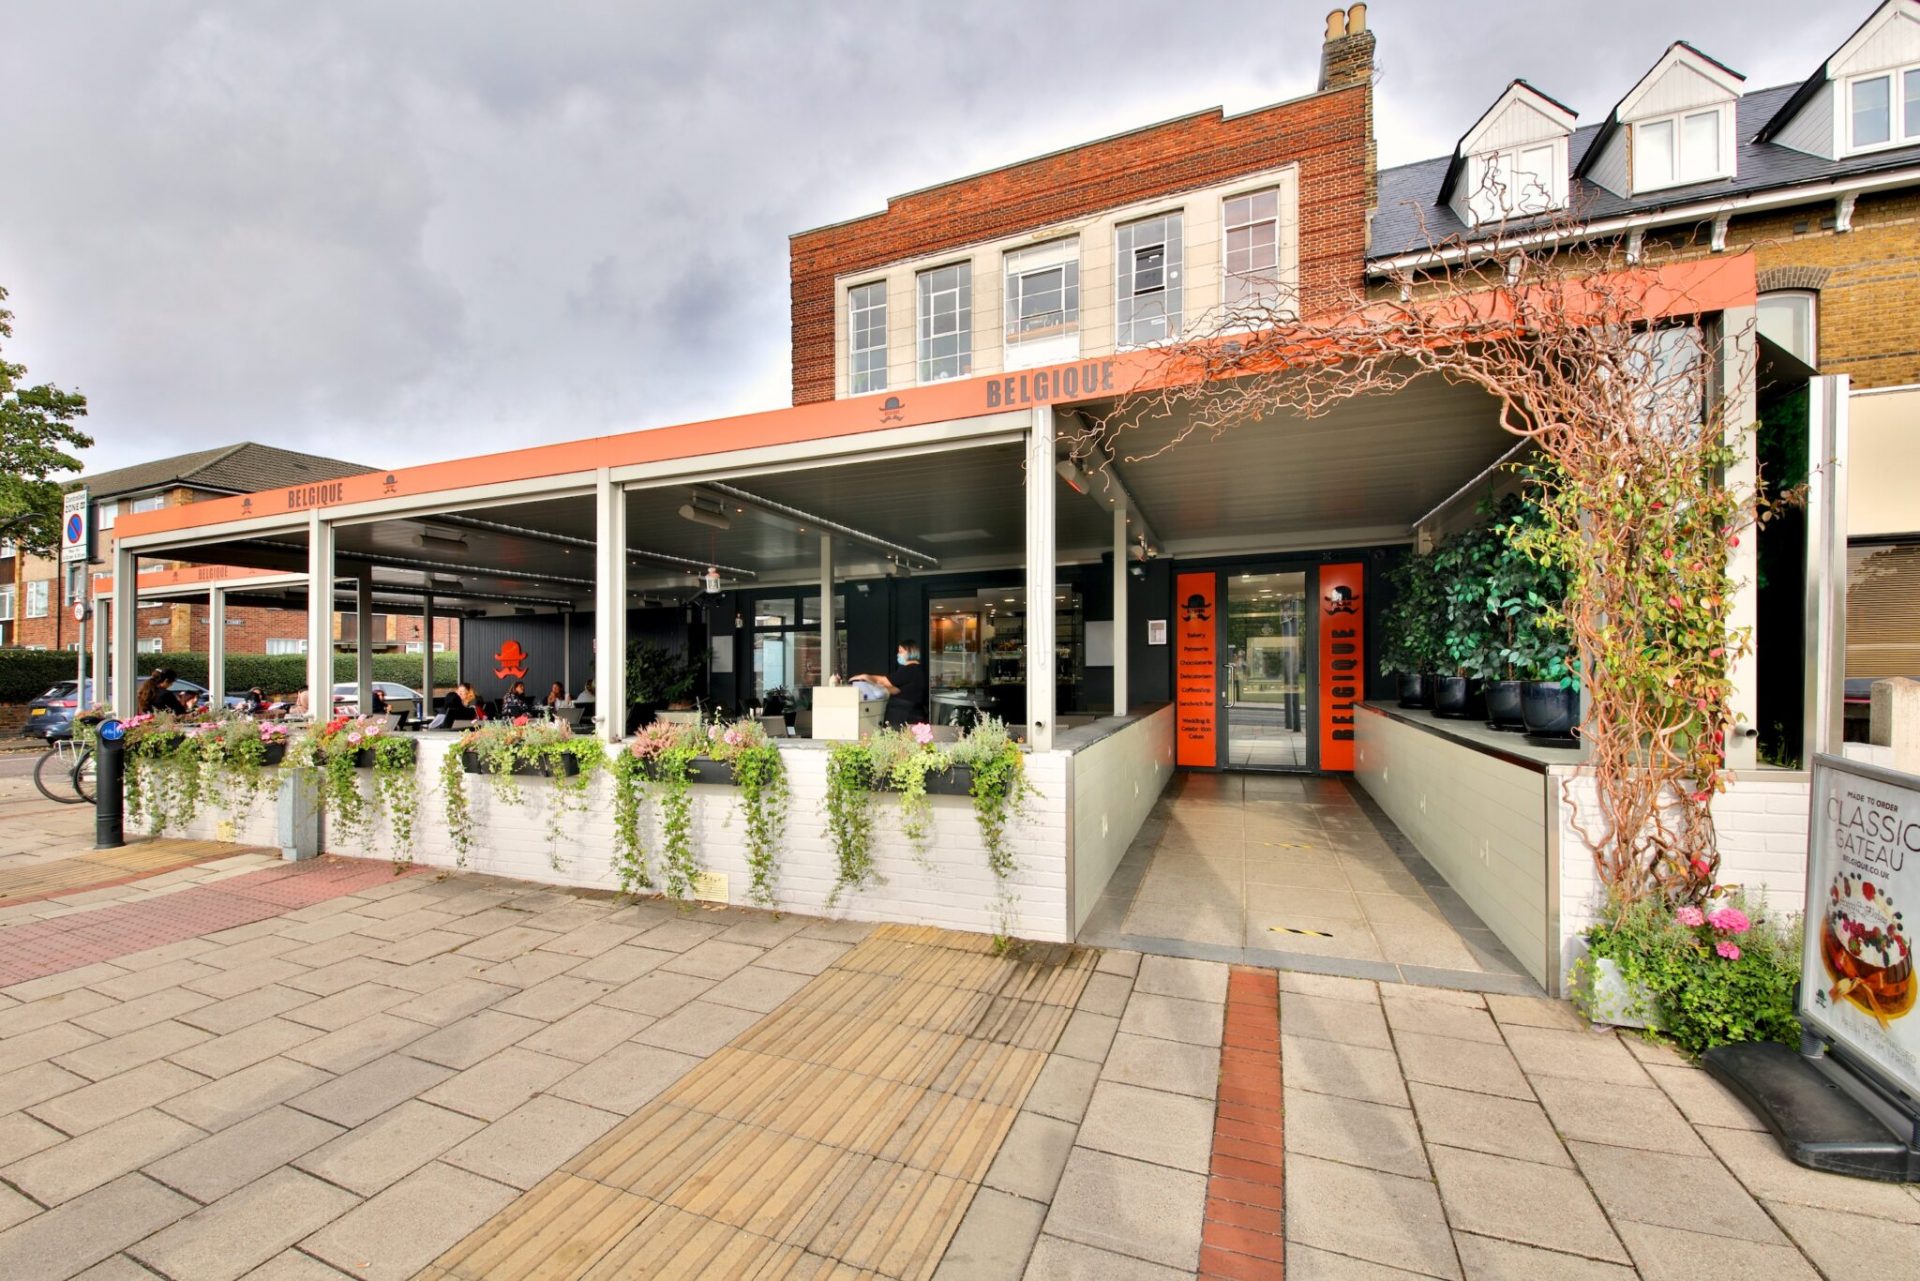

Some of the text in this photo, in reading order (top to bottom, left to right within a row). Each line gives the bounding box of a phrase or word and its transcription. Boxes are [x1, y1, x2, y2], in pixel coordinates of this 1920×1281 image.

[986, 361, 1114, 408] BELGIQUE
[288, 482, 343, 508] BELGIQUE
[198, 566, 228, 580] BELGIQUE
[1331, 629, 1357, 741] BELGIQUE
[1847, 791, 1899, 813] MADE TO ORDER
[1827, 797, 1920, 852] CLASSIC
[1836, 828, 1904, 871] GATEAU
[1842, 854, 1890, 880] BELGIQUE.CO.UK
